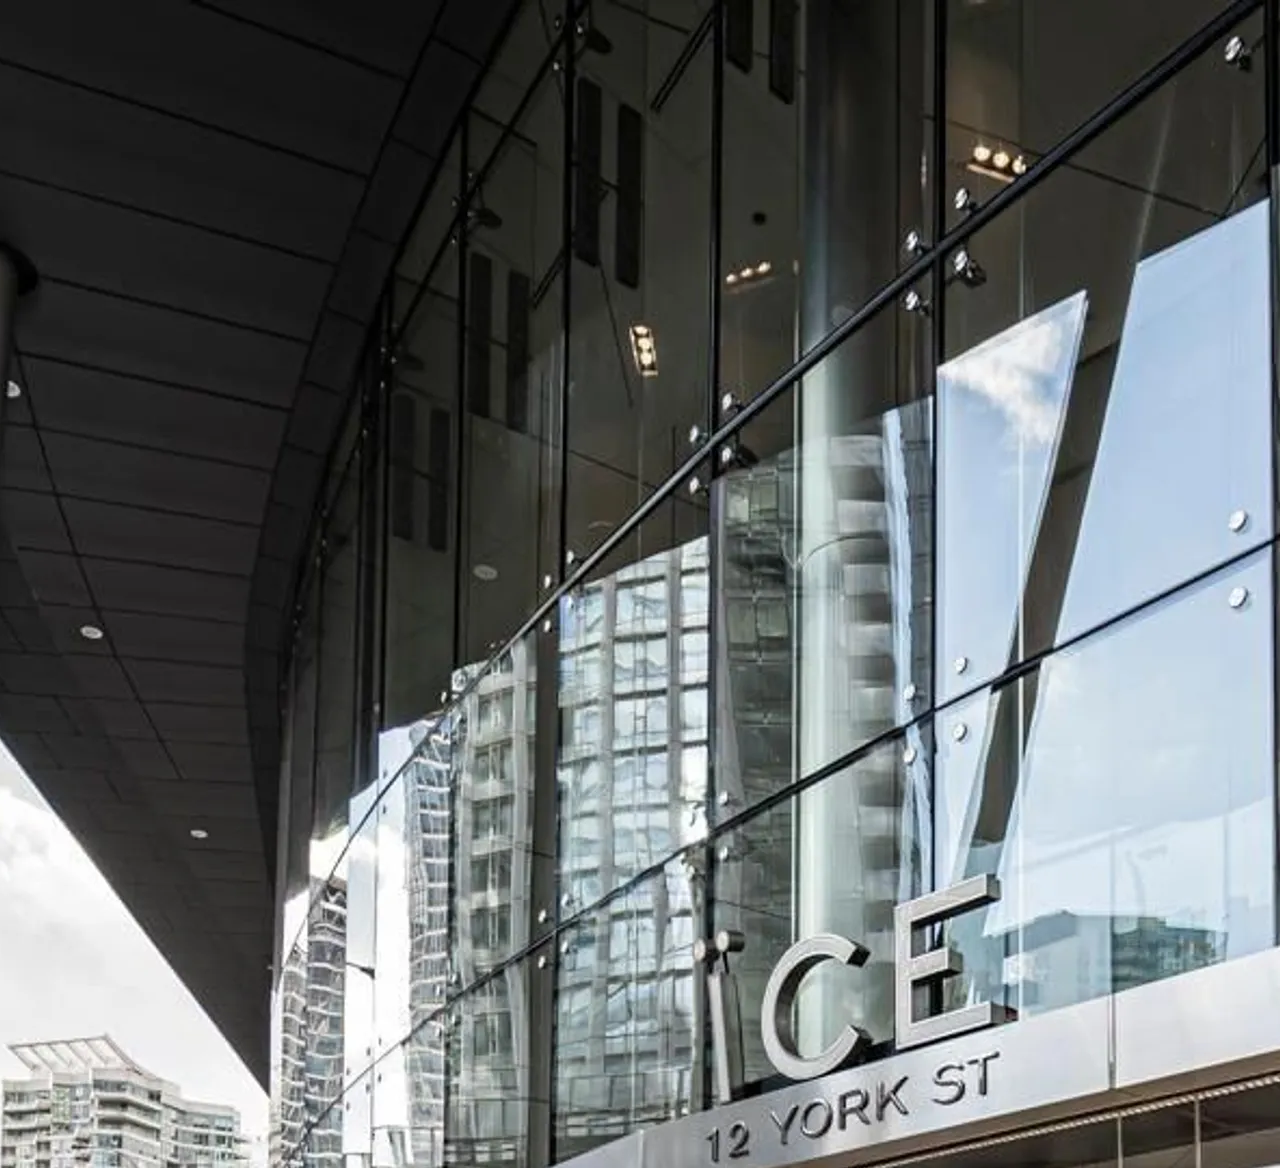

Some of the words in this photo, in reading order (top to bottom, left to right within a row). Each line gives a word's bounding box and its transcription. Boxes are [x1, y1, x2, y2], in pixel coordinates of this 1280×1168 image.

[706, 1120, 751, 1163] 12
[771, 1076, 909, 1146] YORK
[932, 1051, 1001, 1105] ST
